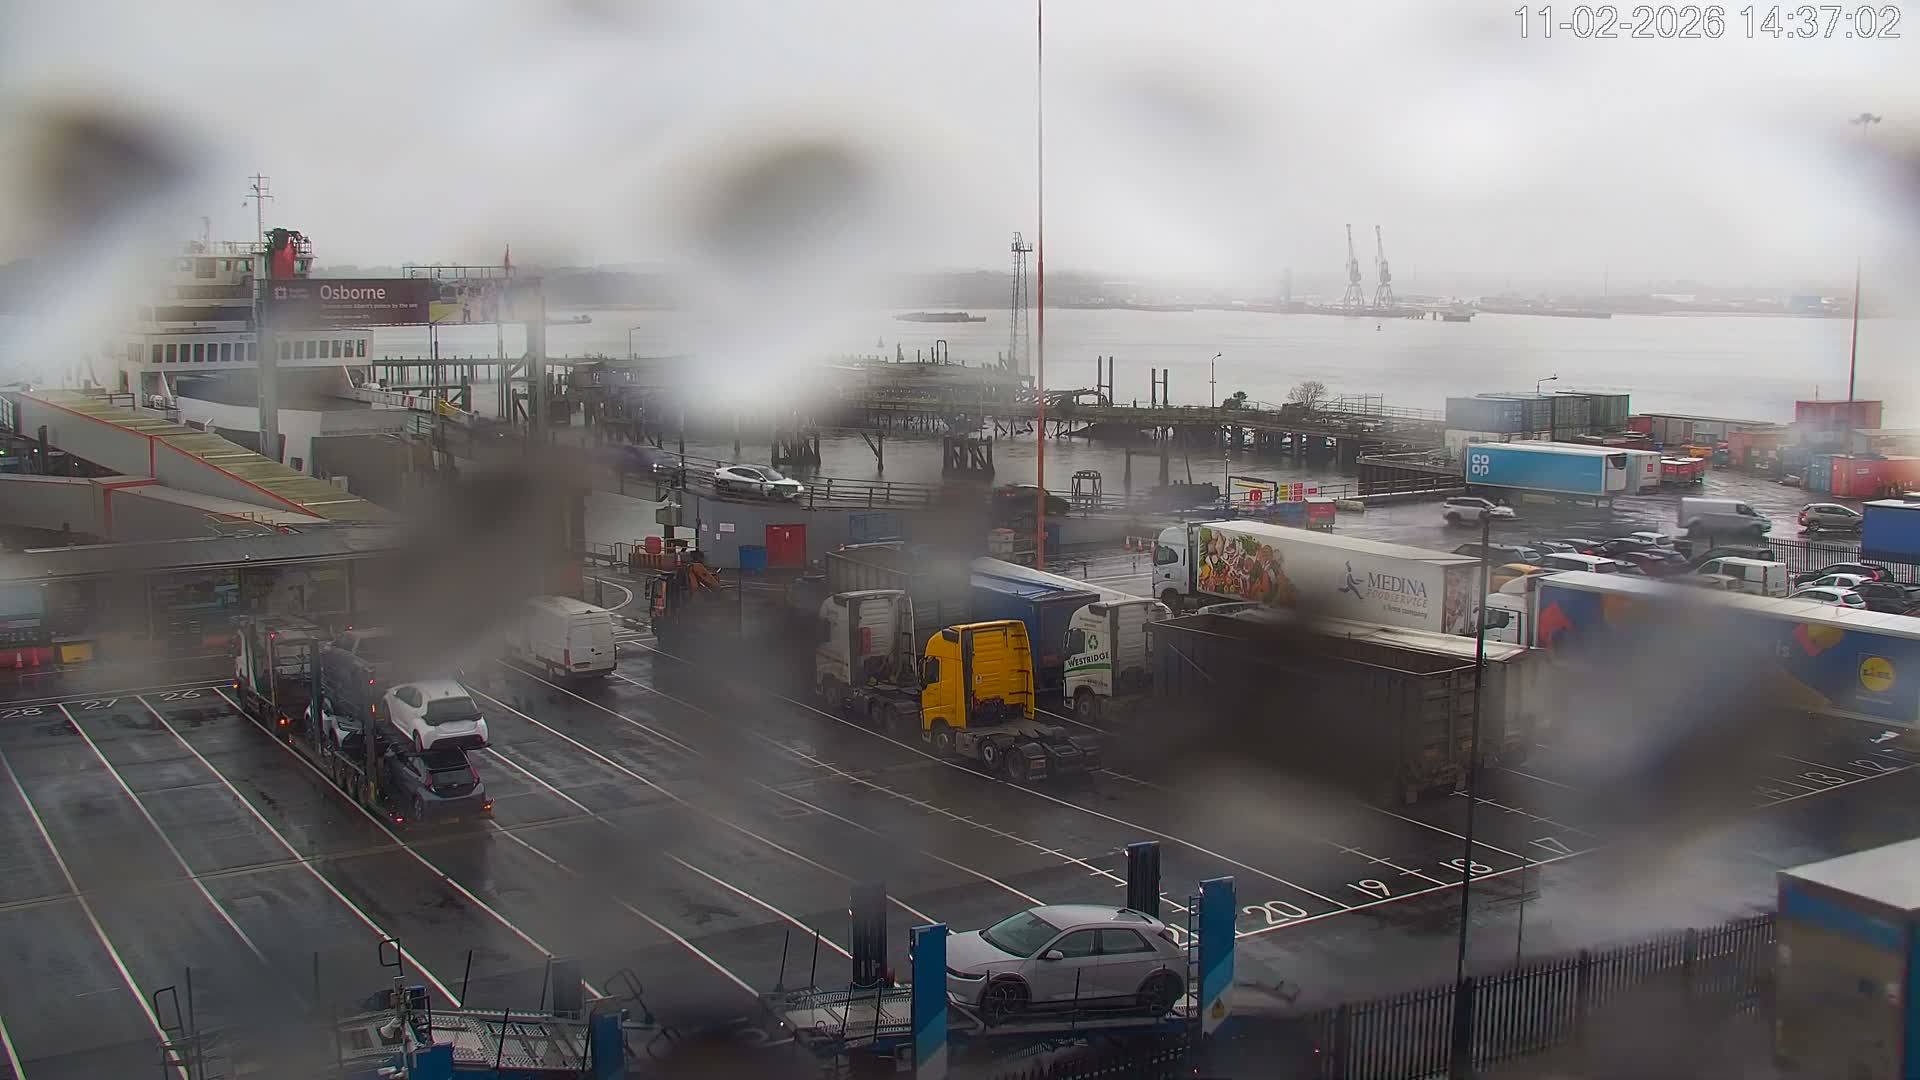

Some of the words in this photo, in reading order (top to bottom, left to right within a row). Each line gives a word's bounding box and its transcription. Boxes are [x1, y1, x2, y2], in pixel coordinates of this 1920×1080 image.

[320, 285, 386, 300] Osborne
[1368, 572, 1427, 598] MEDINA
[1367, 588, 1427, 608] FOODSERVICE
[1067, 652, 1109, 667] WESTRIDGE
[159, 689, 201, 701] 26
[0, 707, 43, 719] 28
[1847, 759, 1897, 773] 12
[1796, 772, 1846, 786] 13
[1528, 836, 1572, 854] 17
[1439, 857, 1493, 877] 18
[1346, 879, 1391, 899] 19
[1242, 900, 1308, 925] 20
